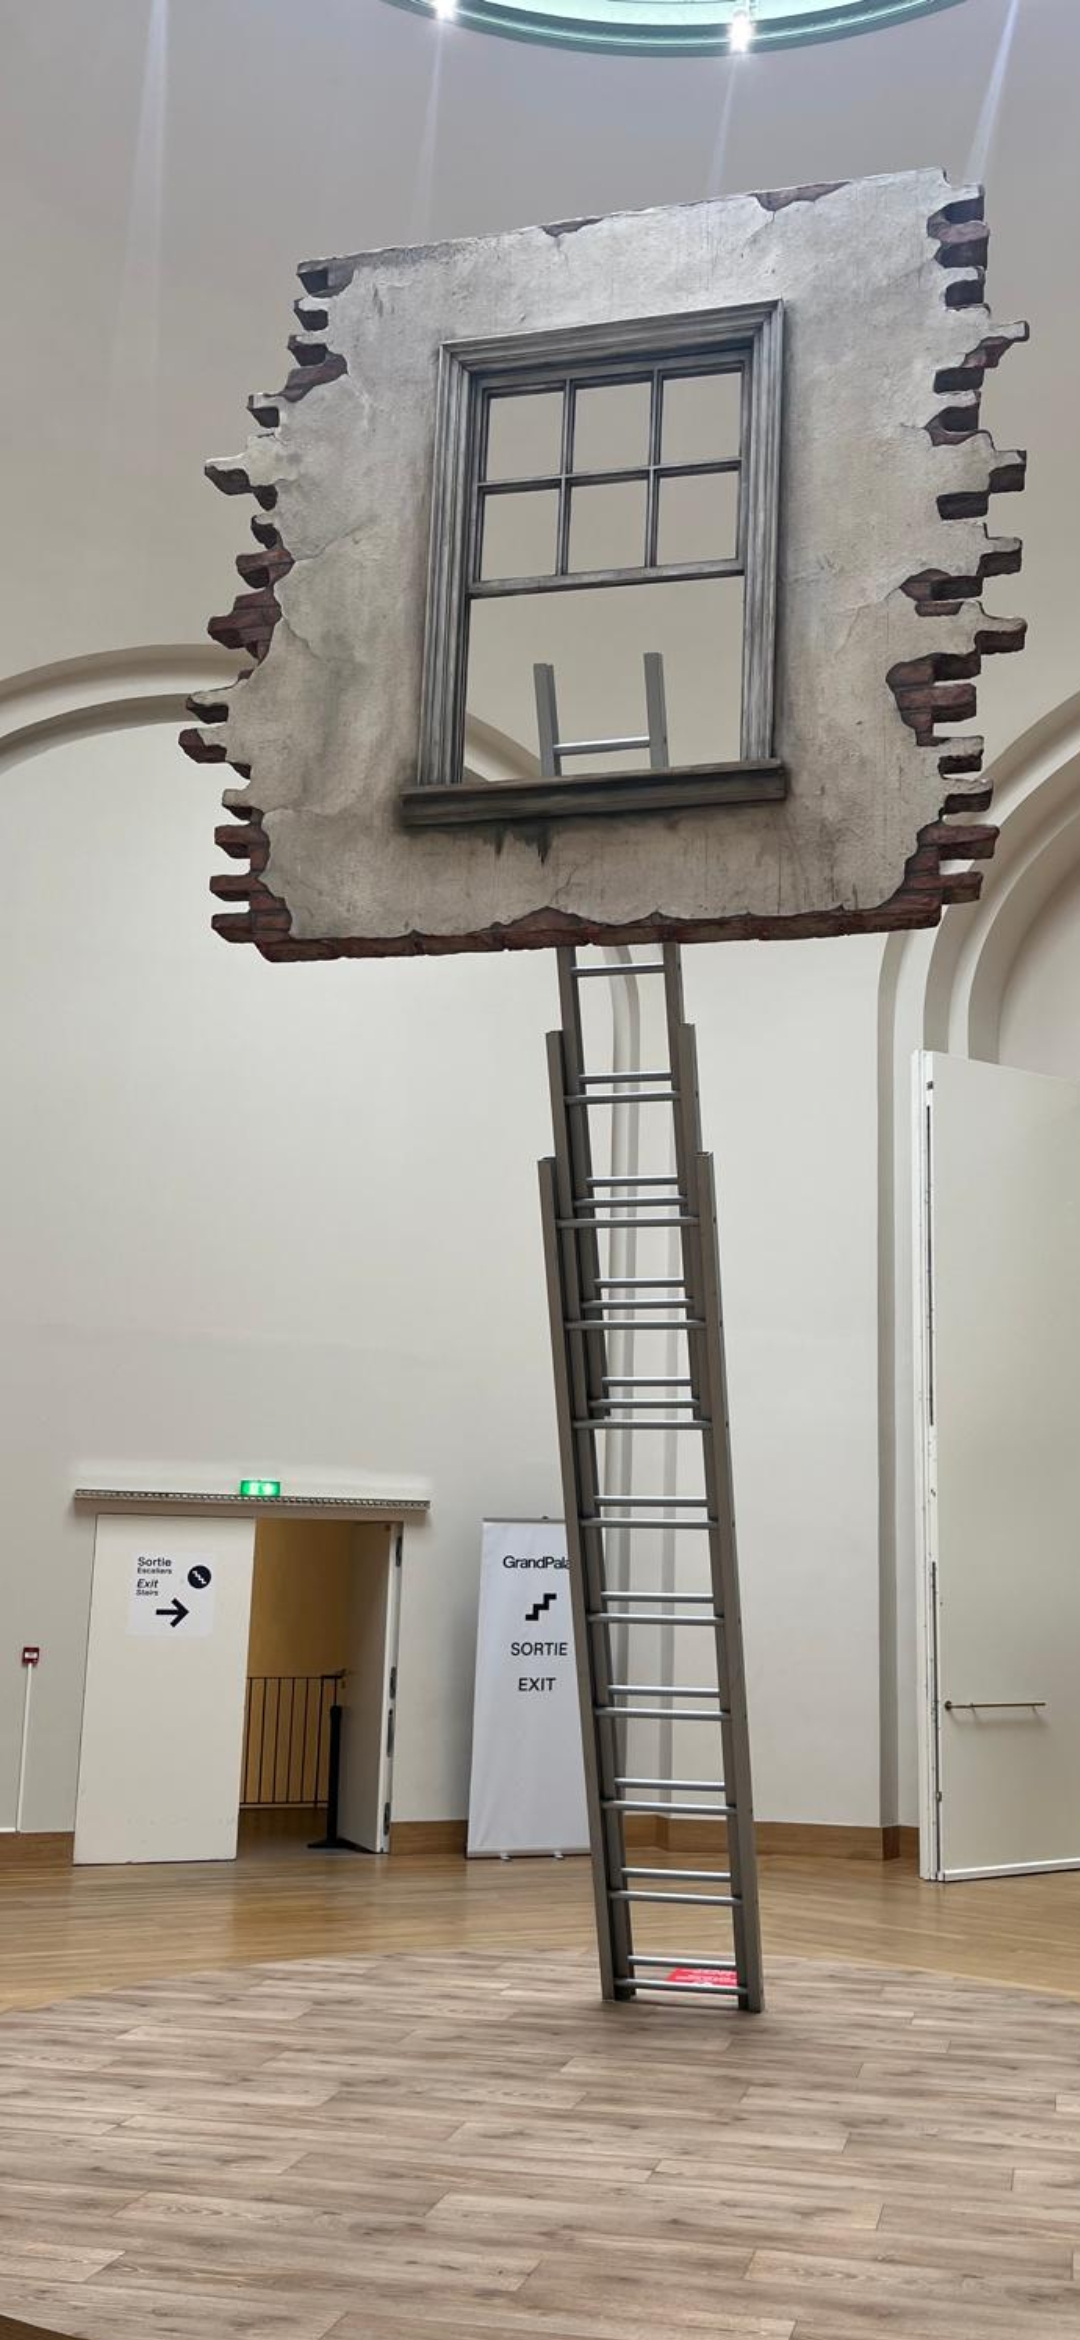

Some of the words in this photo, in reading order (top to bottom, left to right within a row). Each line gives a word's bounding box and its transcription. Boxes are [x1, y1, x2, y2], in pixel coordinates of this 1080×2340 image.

[137, 1556, 172, 1567] Sortie
[137, 1578, 159, 1588] Exit
[511, 1642, 568, 1656] SORTIE
[518, 1677, 556, 1691] EXIT
